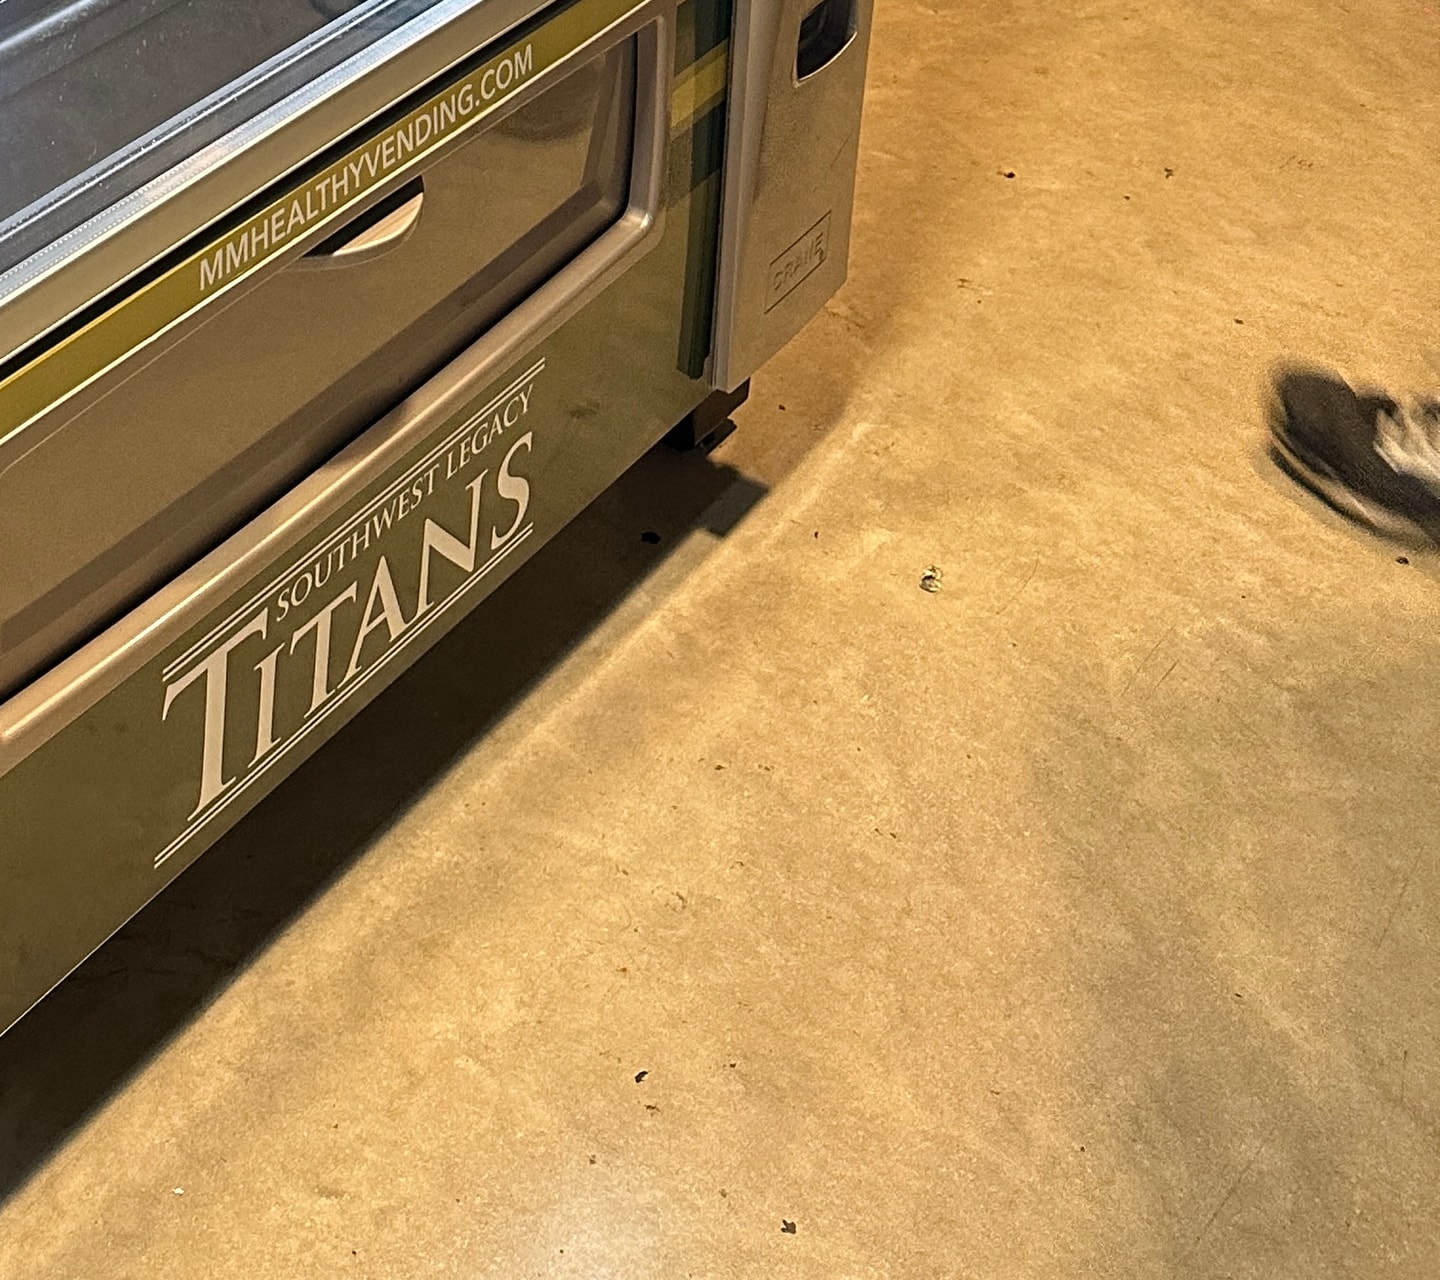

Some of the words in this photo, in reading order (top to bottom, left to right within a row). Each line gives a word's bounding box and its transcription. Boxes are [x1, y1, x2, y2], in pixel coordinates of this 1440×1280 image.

[198, 43, 534, 291] MMHEALTHYVENDING.COM
[771, 230, 827, 292] CRANE
[276, 463, 441, 623] SOUTHWEST
[445, 383, 535, 480] LEGACY
[162, 430, 535, 822] TITANS
